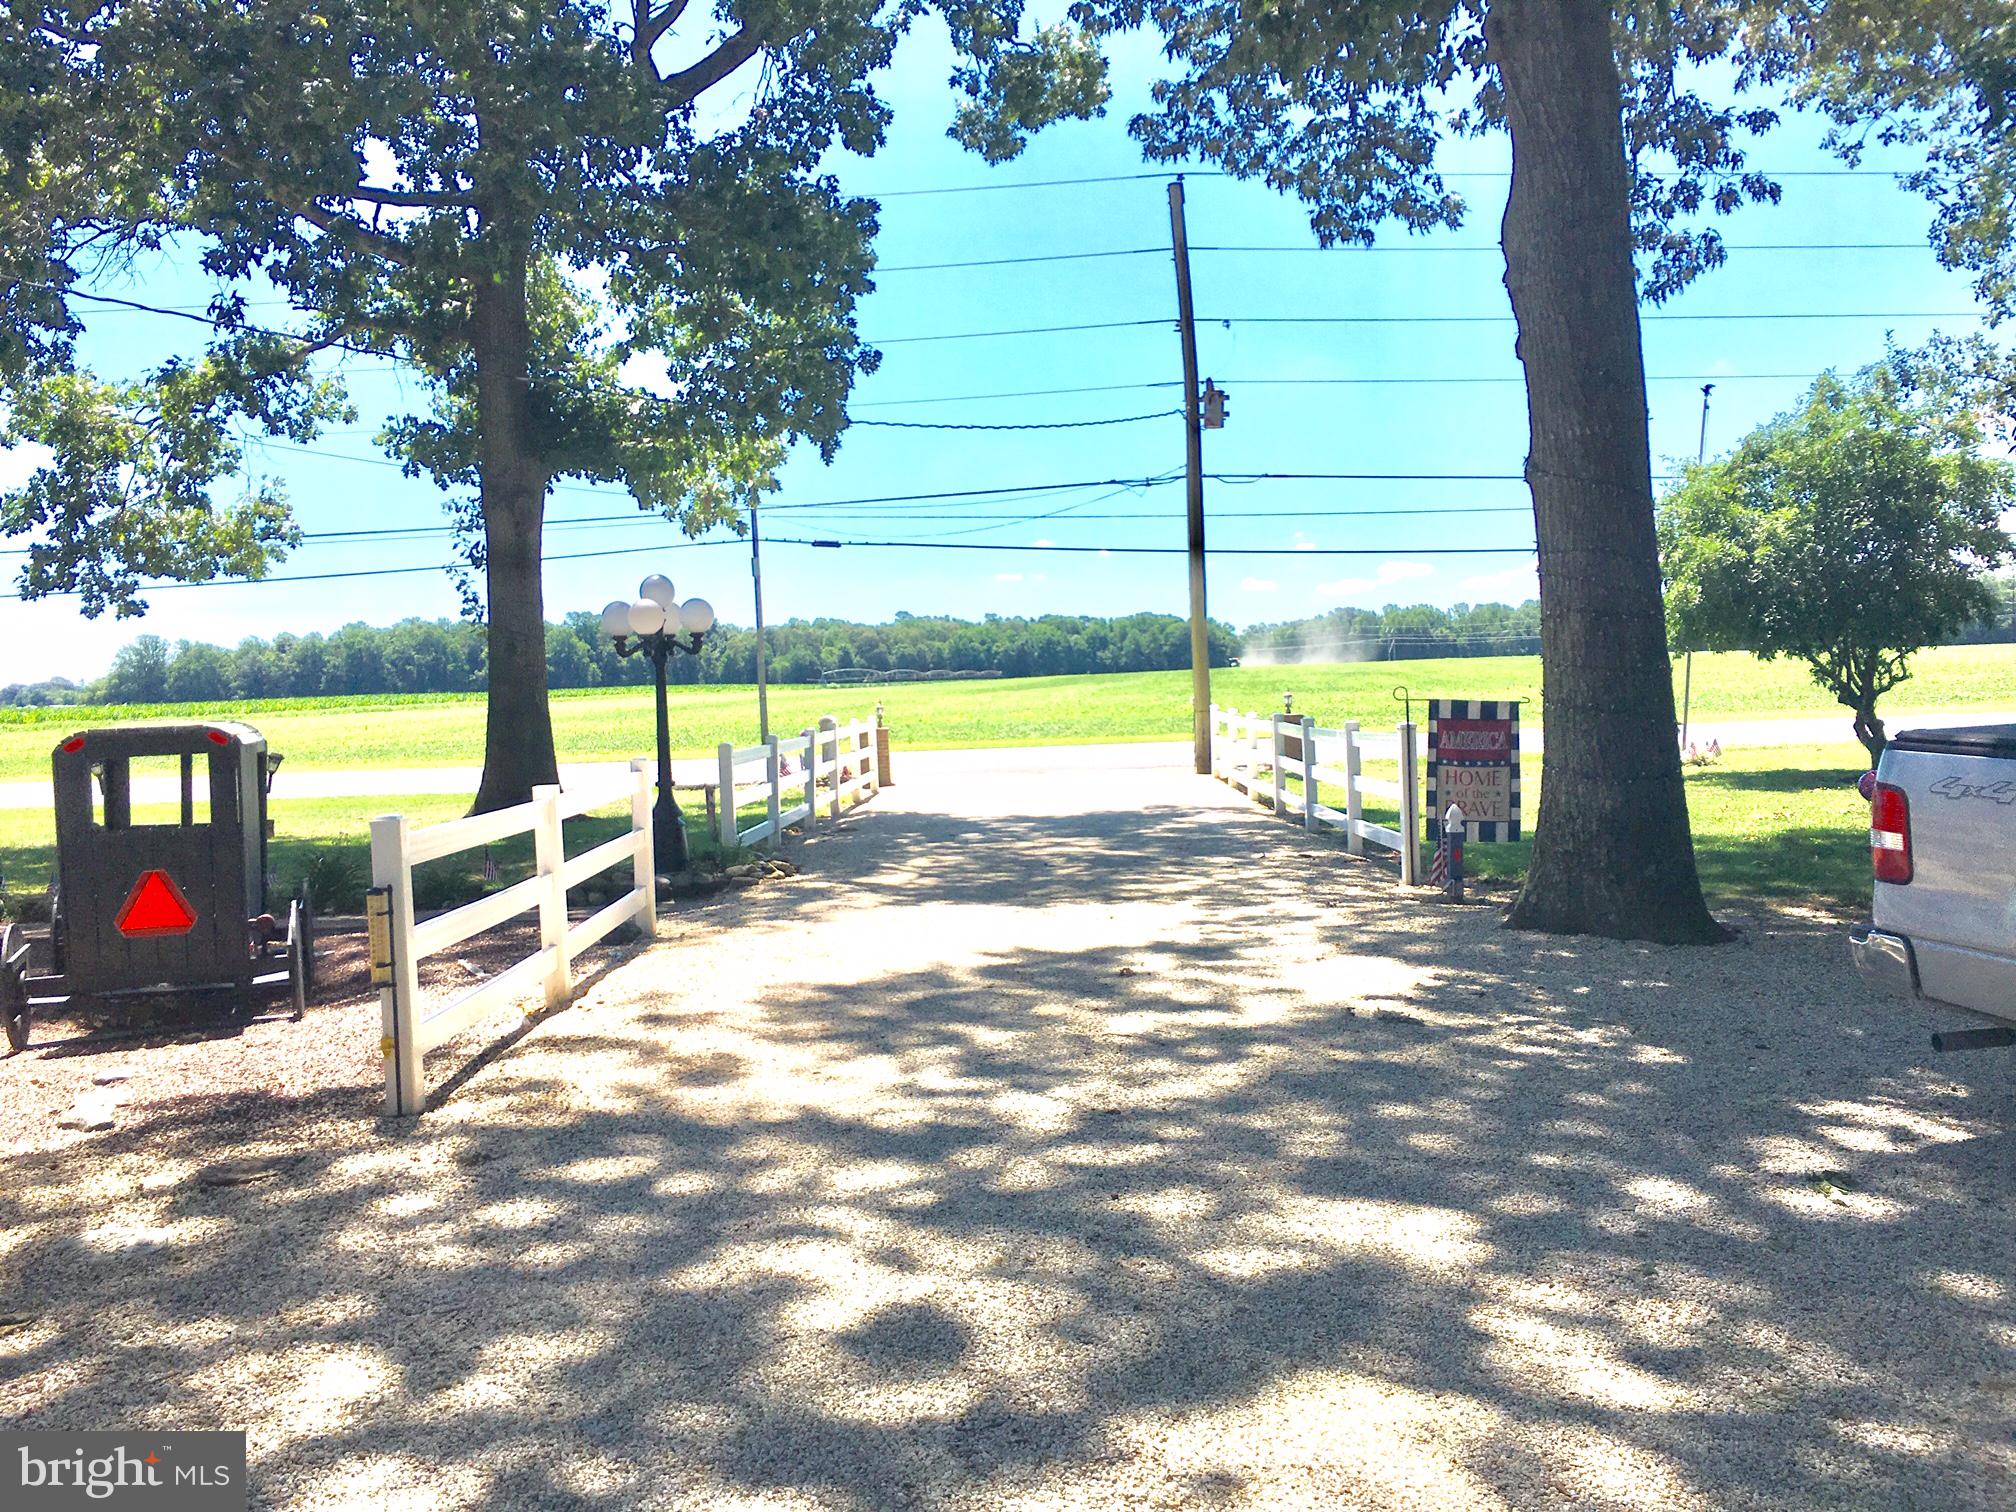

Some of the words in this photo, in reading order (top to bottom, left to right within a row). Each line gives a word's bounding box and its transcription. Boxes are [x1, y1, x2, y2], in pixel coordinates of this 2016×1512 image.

[1440, 731, 1508, 750] AMERICA
[1445, 769, 1503, 786] HOME
[1456, 787, 1470, 798] of
[1472, 788, 1490, 799] the
